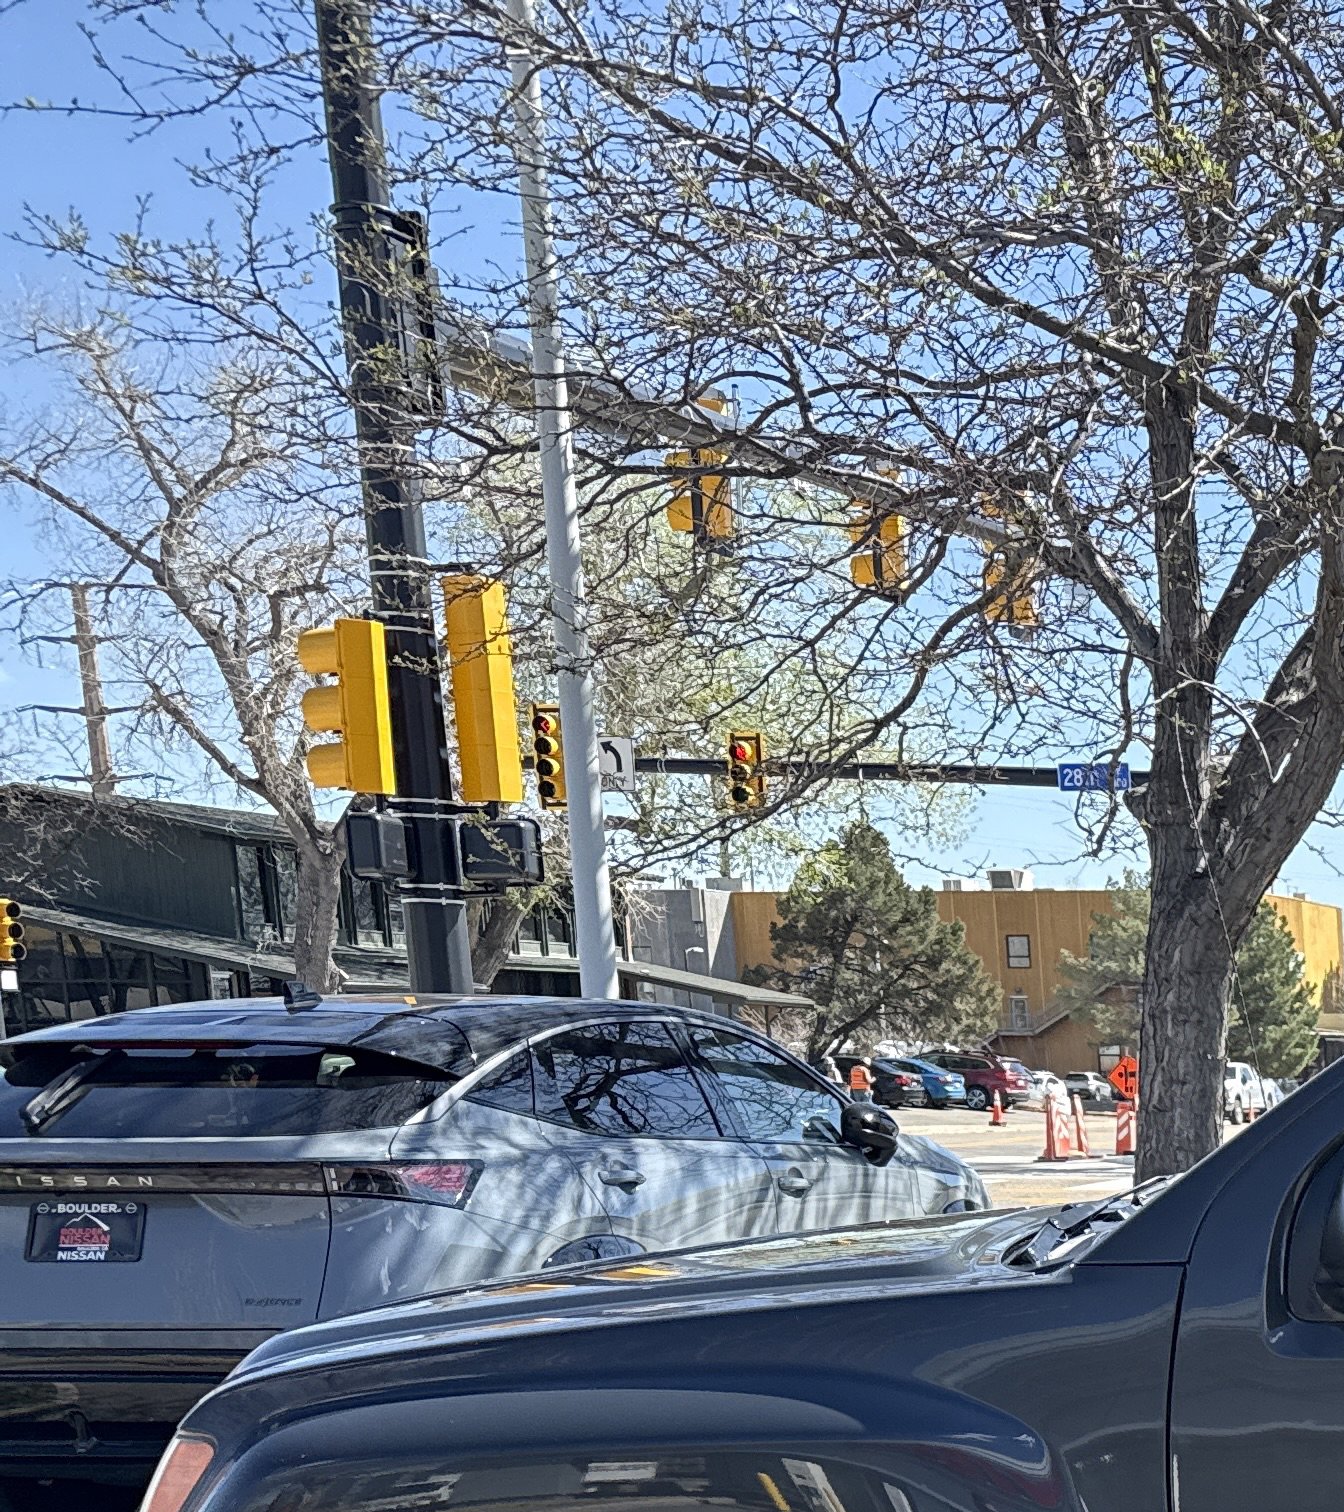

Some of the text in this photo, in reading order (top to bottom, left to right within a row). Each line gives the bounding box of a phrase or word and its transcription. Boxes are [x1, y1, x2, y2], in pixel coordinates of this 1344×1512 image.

[57, 1204, 118, 1213] BOULDER
[60, 1234, 110, 1244] NISSAN
[57, 1251, 106, 1260] NISSAN
